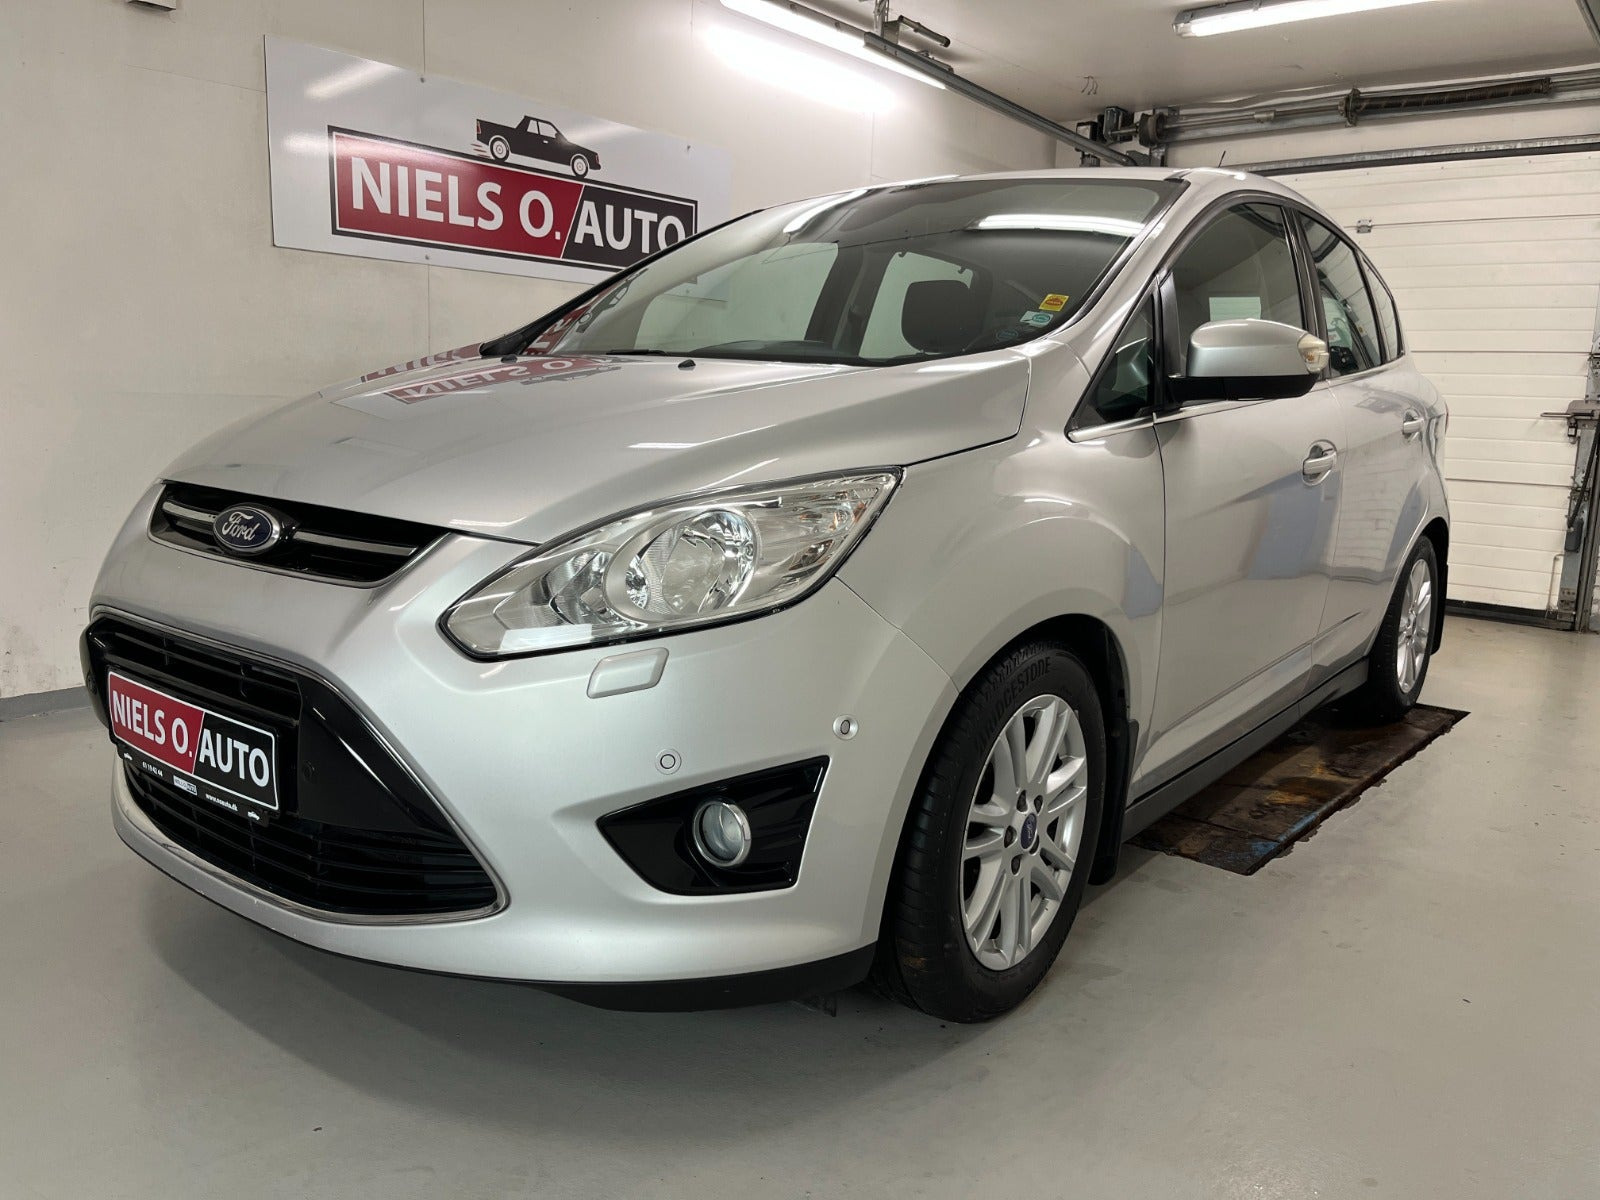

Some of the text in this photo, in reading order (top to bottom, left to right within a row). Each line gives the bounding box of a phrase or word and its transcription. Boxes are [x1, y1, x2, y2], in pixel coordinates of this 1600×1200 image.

[351, 156, 686, 255] NIELS O. AUTO
[221, 512, 260, 541] Ford
[112, 690, 270, 787] NIELS O. AUTO
